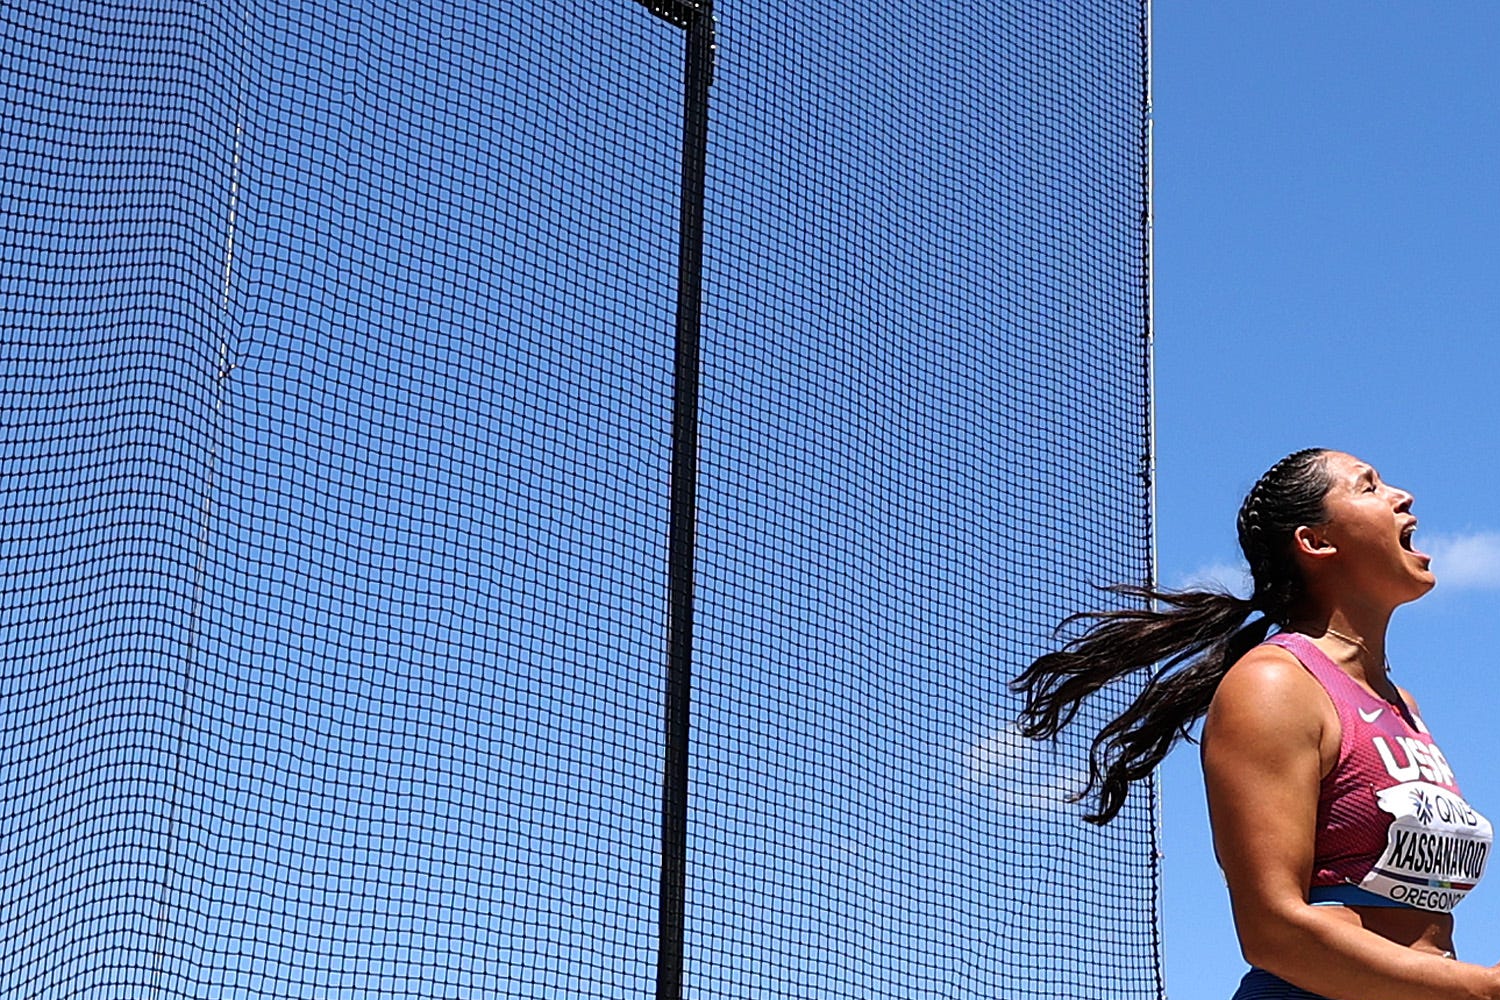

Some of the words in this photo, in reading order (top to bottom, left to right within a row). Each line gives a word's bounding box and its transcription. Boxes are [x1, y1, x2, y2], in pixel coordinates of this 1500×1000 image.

[1372, 736, 1454, 786] USA
[1435, 795, 1477, 827] QNB
[1387, 829, 1487, 879] KASSANAVOID
